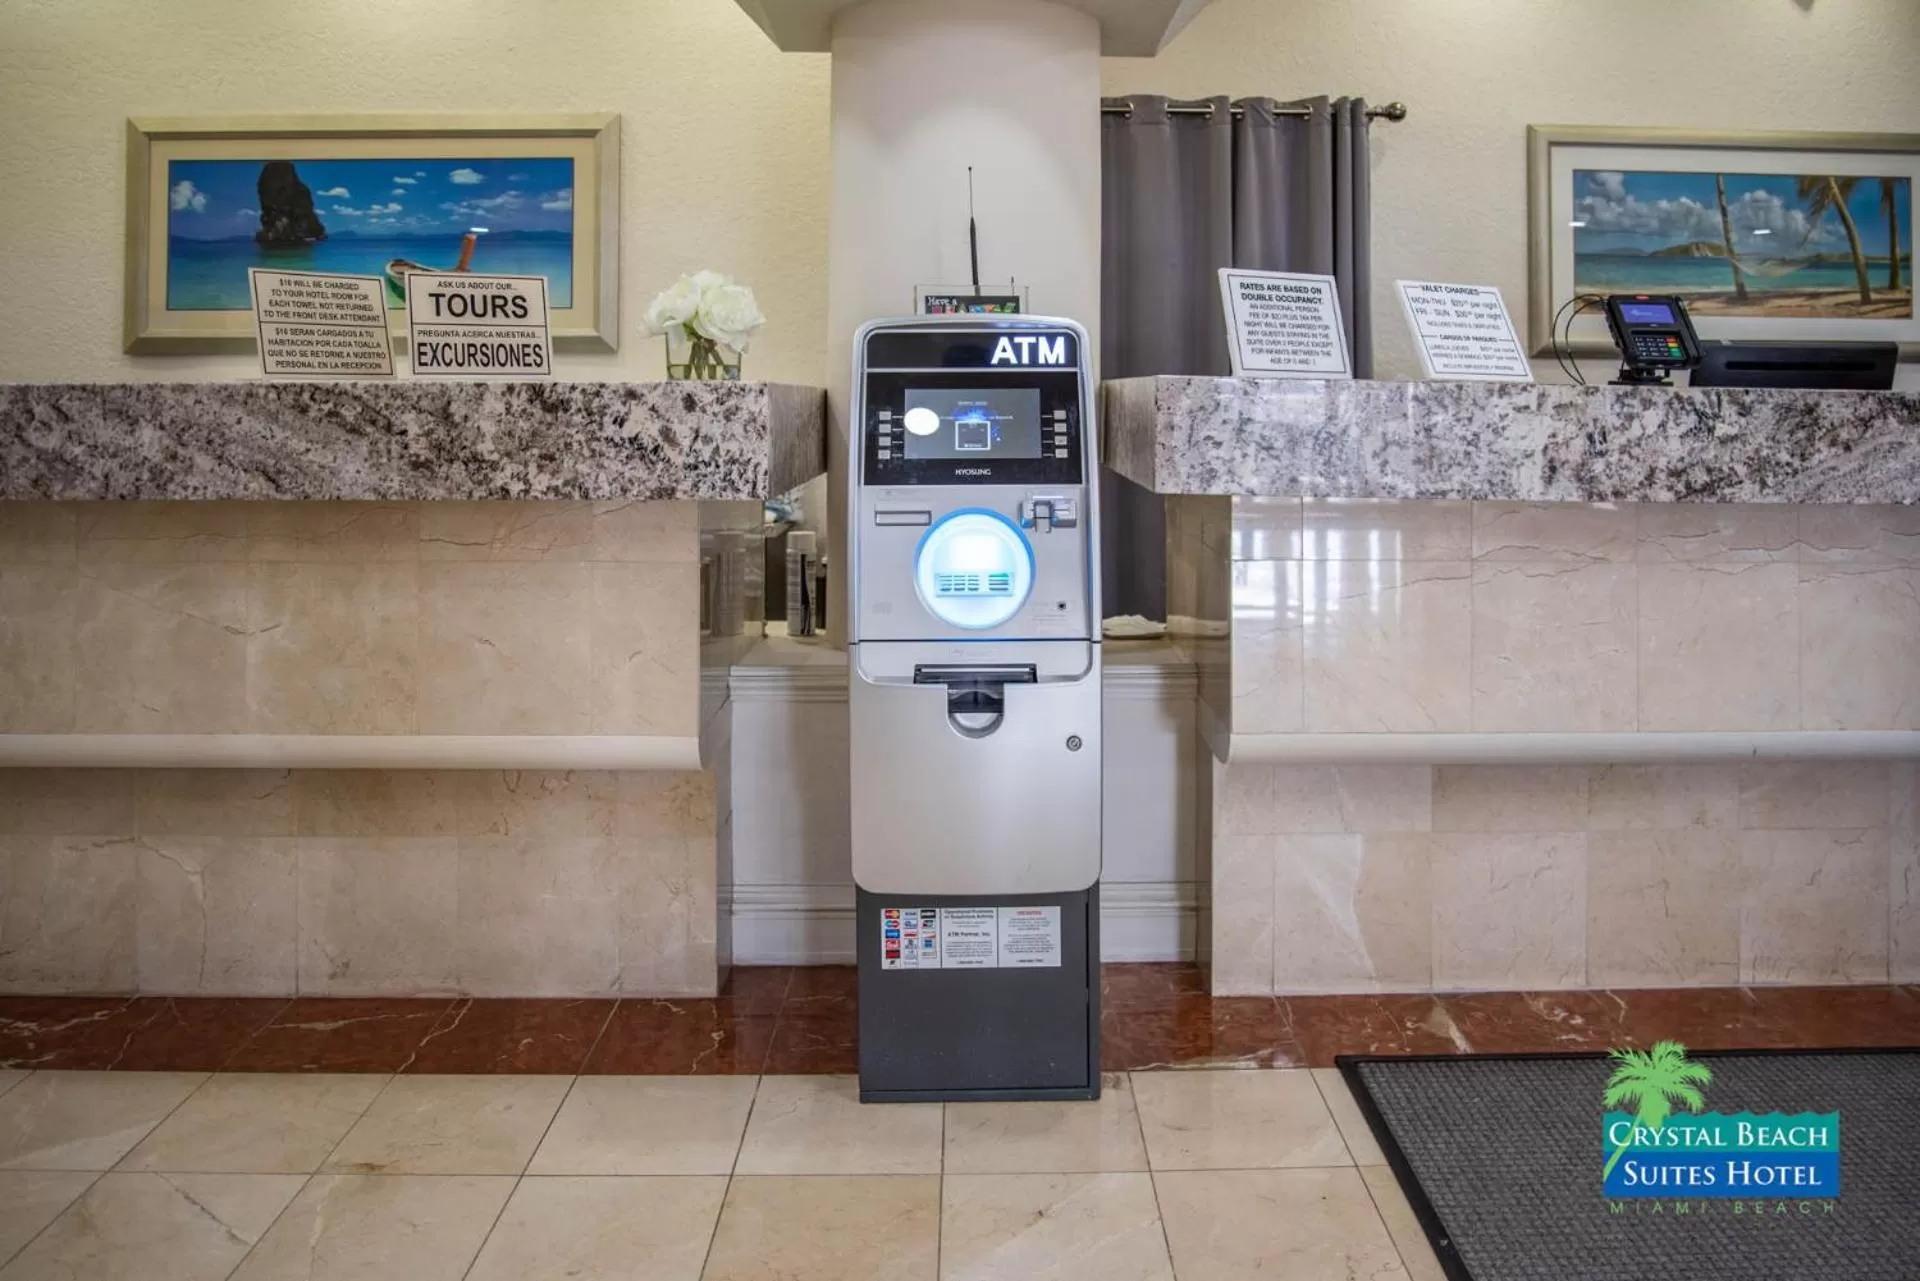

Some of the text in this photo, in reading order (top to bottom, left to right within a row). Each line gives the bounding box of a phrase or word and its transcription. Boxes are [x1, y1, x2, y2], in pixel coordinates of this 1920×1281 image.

[324, 281, 359, 290] CHARGED
[1240, 283, 1265, 291] RATES
[1267, 284, 1282, 292] ARE
[1283, 285, 1308, 293] BASED
[284, 290, 304, 298] YOUR
[306, 291, 329, 299] HOTEL
[331, 292, 353, 300] ROOM
[1445, 287, 1479, 295] CHARGES
[1241, 293, 1273, 301] DOUBLE
[292, 301, 317, 309] TOWEL
[336, 303, 373, 311] RETURNED
[428, 293, 528, 318] TOURS
[293, 311, 316, 320] FRONT
[319, 312, 339, 321] DESK
[341, 313, 380, 322] ATTENDANT
[290, 328, 315, 336] SERAN
[316, 329, 357, 337] CARGADOS
[462, 330, 493, 338] ACERCA
[268, 349, 284, 357] QUE
[418, 343, 543, 367] EXCURSIONES
[991, 336, 1064, 364] ATM
